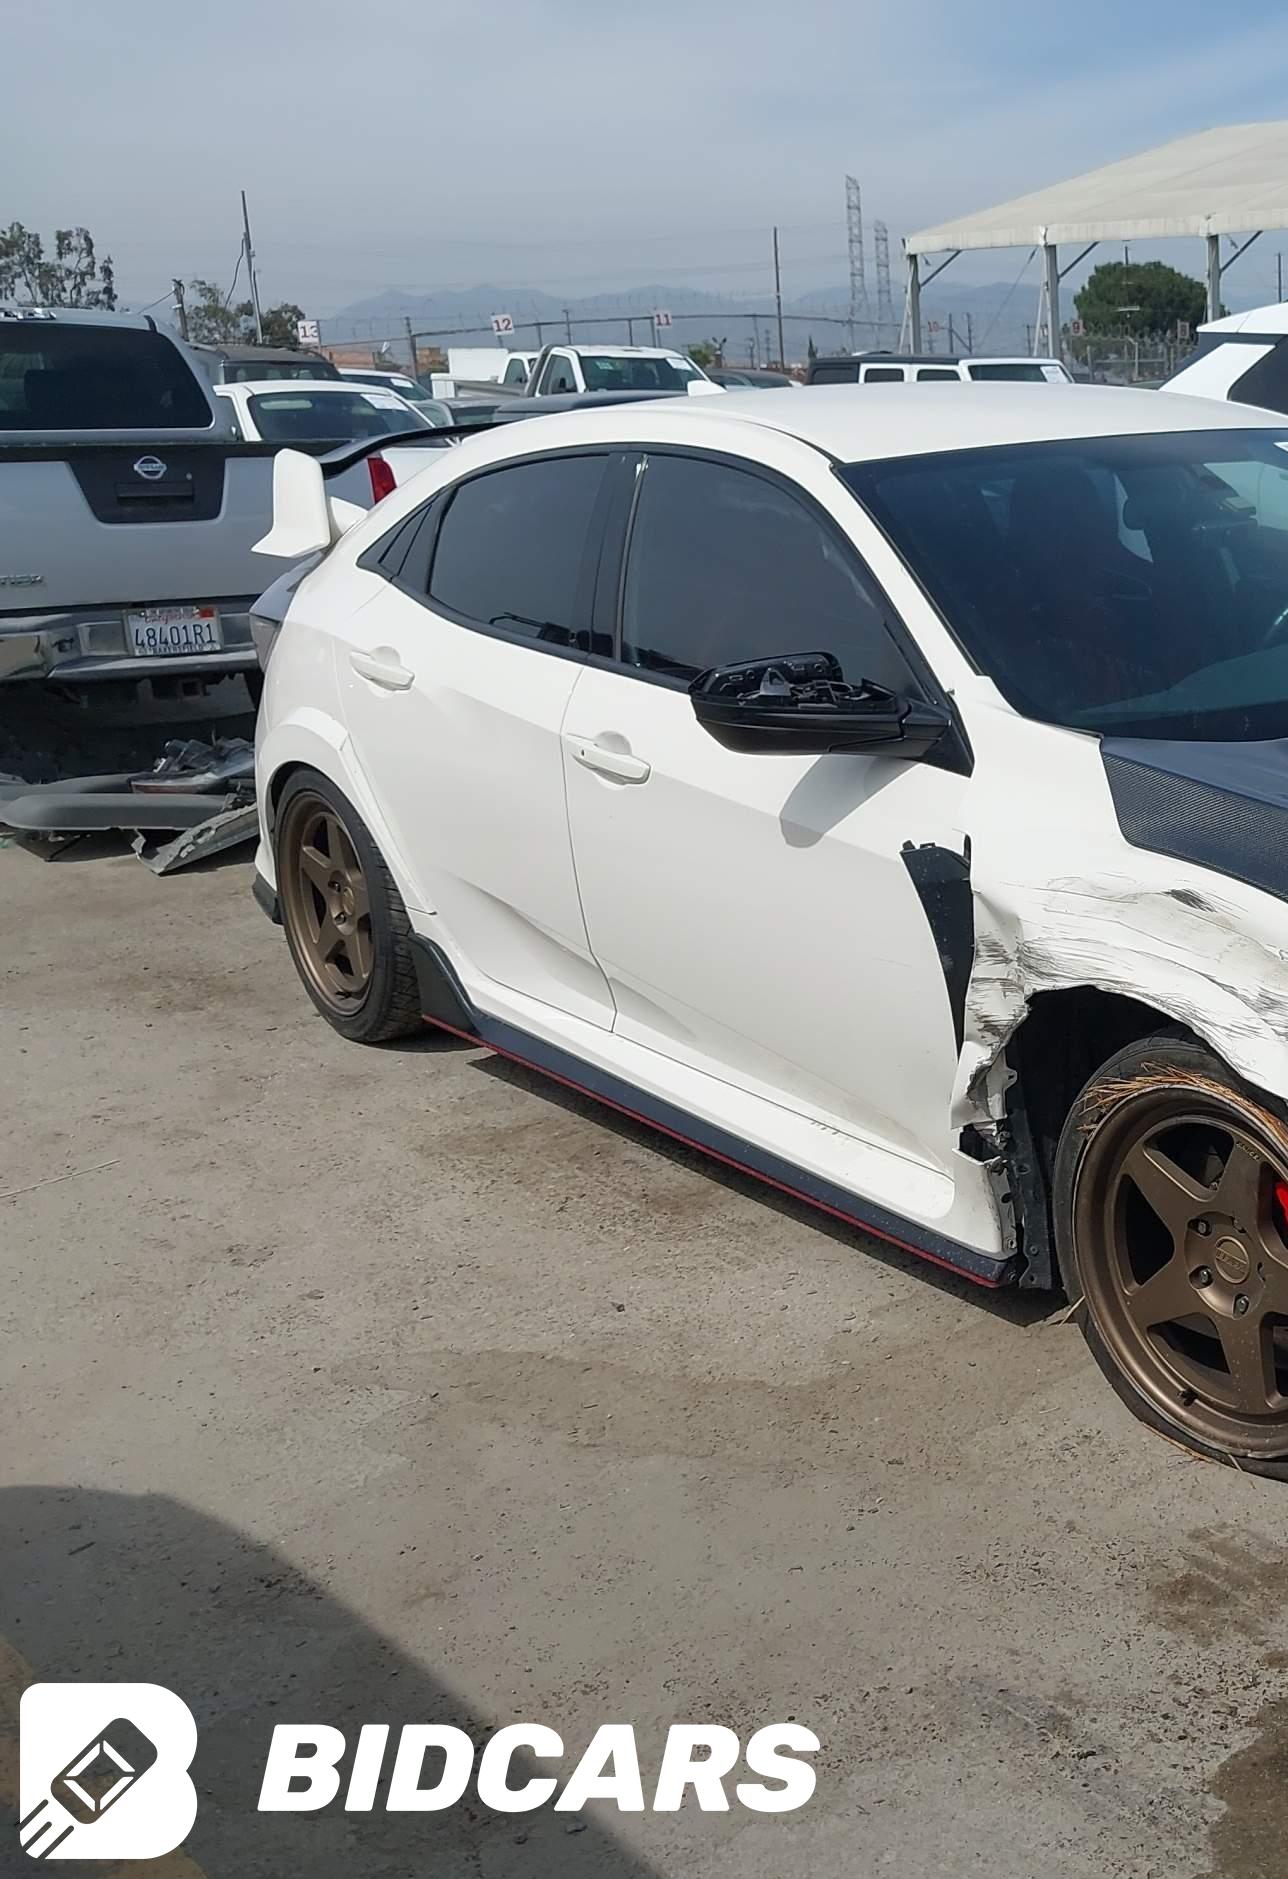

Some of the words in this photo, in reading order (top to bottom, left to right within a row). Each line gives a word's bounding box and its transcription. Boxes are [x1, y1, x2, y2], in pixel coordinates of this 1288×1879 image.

[494, 318, 512, 332] 12
[656, 314, 672, 326] 11
[301, 325, 318, 338] 13
[135, 623, 216, 648] 48401R1
